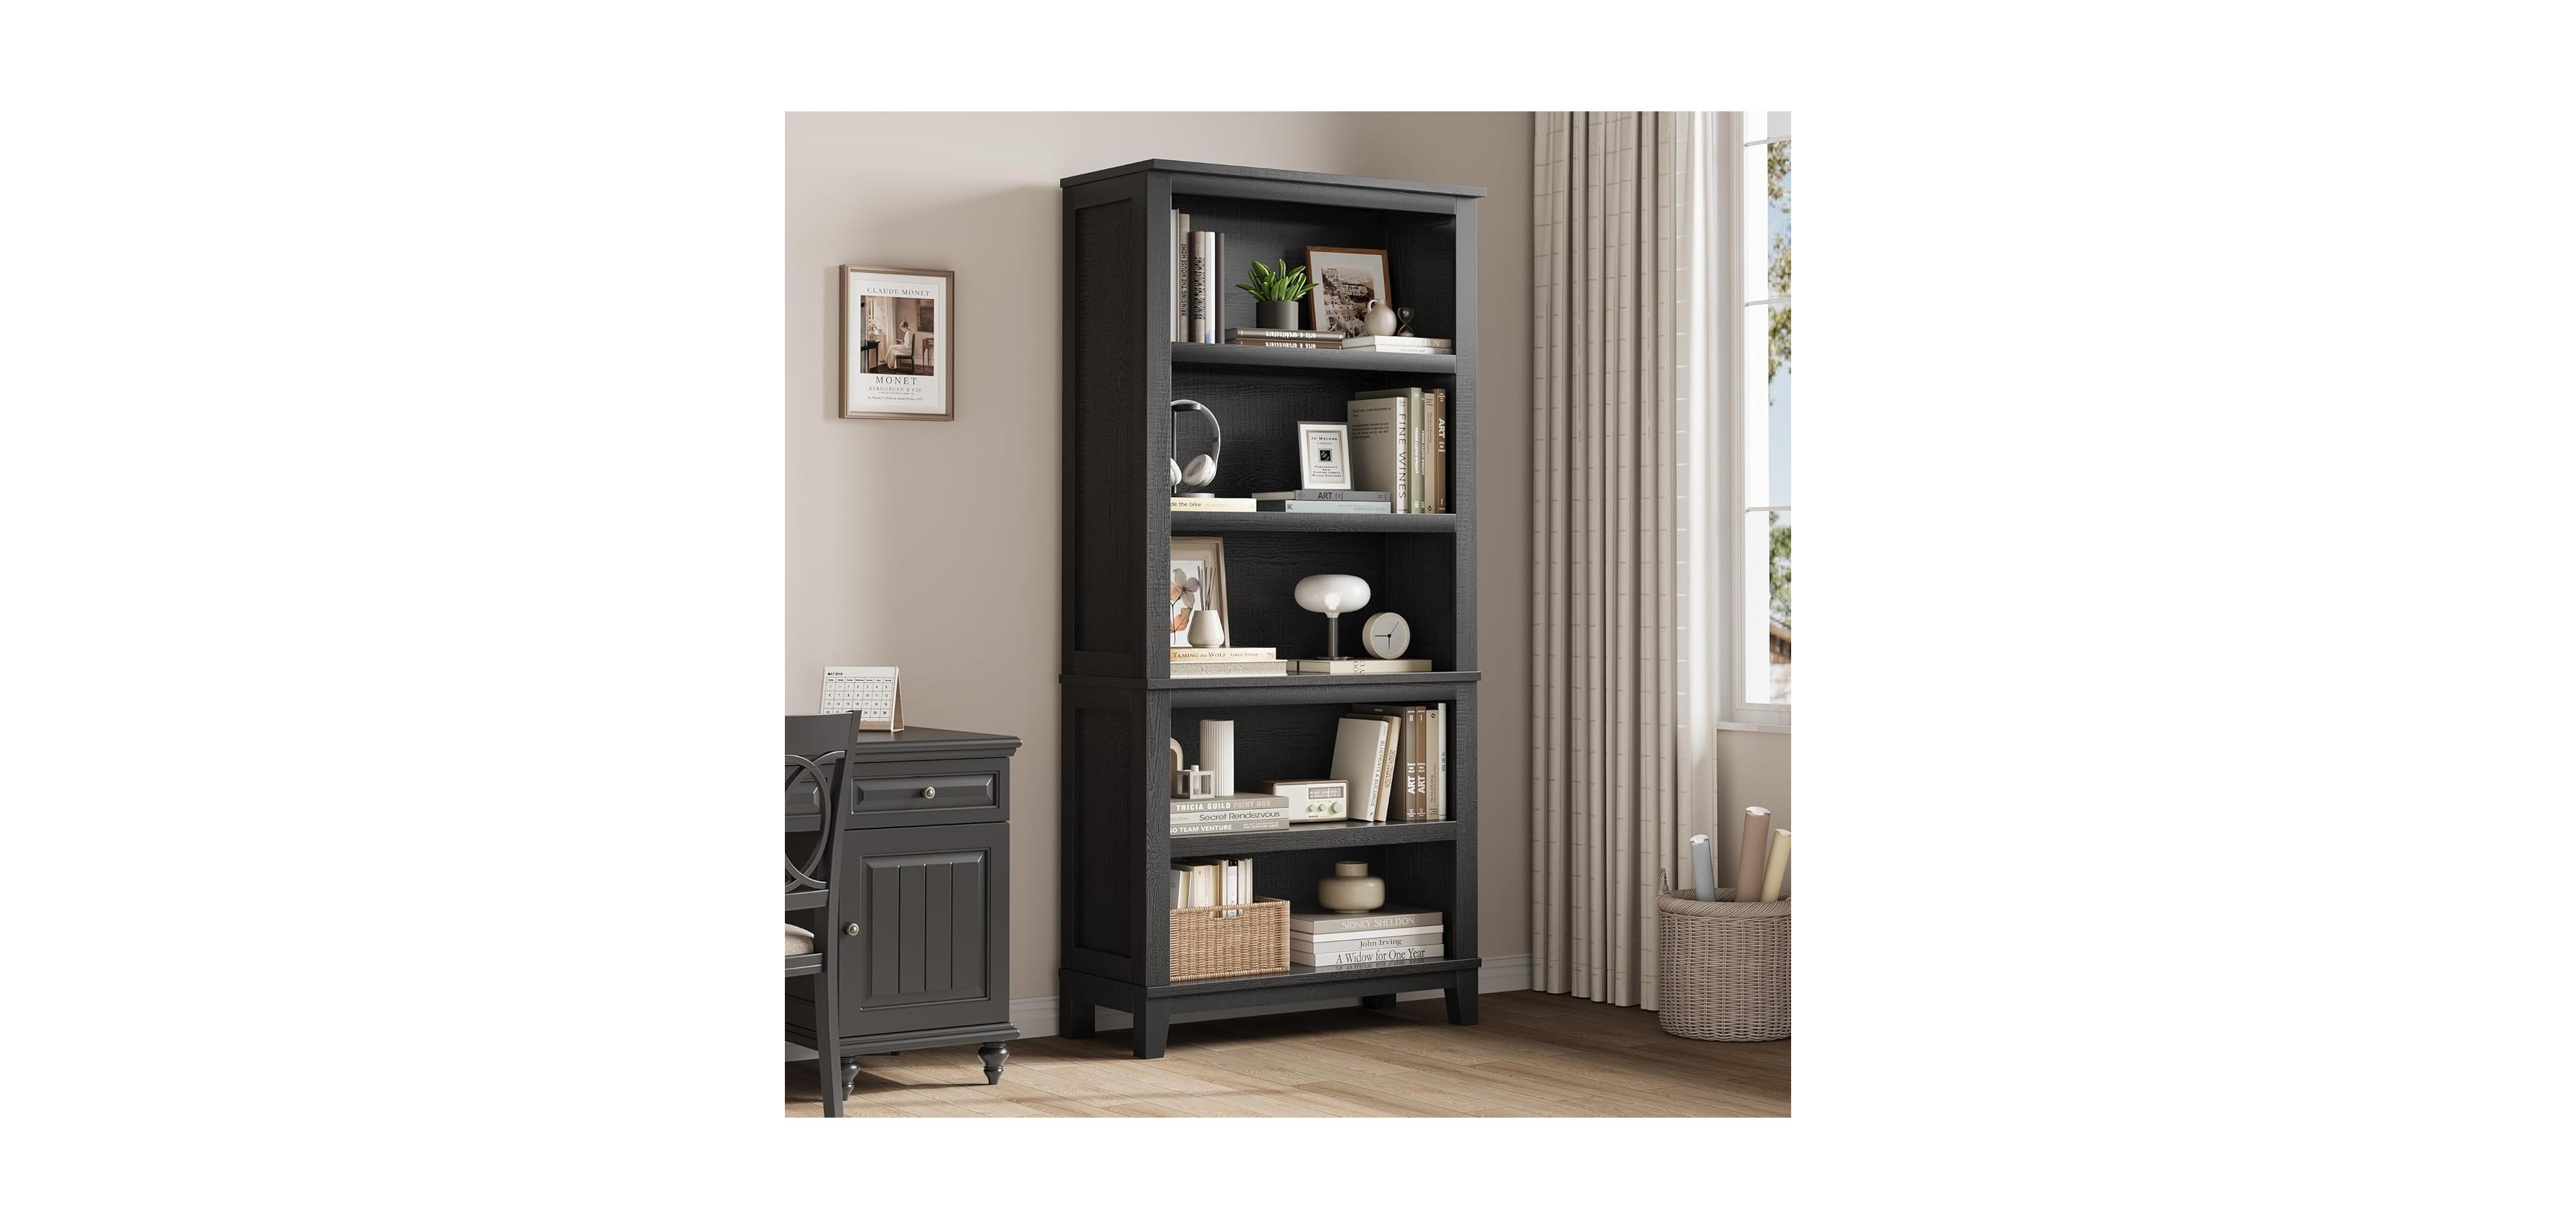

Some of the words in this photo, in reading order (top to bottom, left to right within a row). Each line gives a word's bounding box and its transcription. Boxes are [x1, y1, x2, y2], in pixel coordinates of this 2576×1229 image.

[1194, 256, 1205, 270] HOME
[1194, 272, 1205, 286] HOUSE
[1194, 287, 1205, 297] THE
[1194, 297, 1205, 320] BRINGING
[875, 376, 917, 384] MONET
[1318, 492, 1333, 500] ART
[1376, 740, 1385, 773] BLUEPRINTS
[1385, 764, 1393, 788] COLLECTION
[1407, 776, 1415, 795] ART
[1417, 775, 1426, 794] ART
[1371, 778, 1379, 806] BUILDINGS
[1229, 811, 1280, 820] Rendezvous
[1342, 920, 1372, 930] SIDNEY
[1375, 916, 1415, 927] SHELDON
[1359, 940, 1377, 949] John
[1379, 939, 1402, 947] Irving
[1336, 954, 1343, 964] A
[1345, 951, 1373, 963] Widow
[1376, 949, 1387, 961] for
[1389, 949, 1405, 960] One
[1407, 948, 1426, 958] Year
